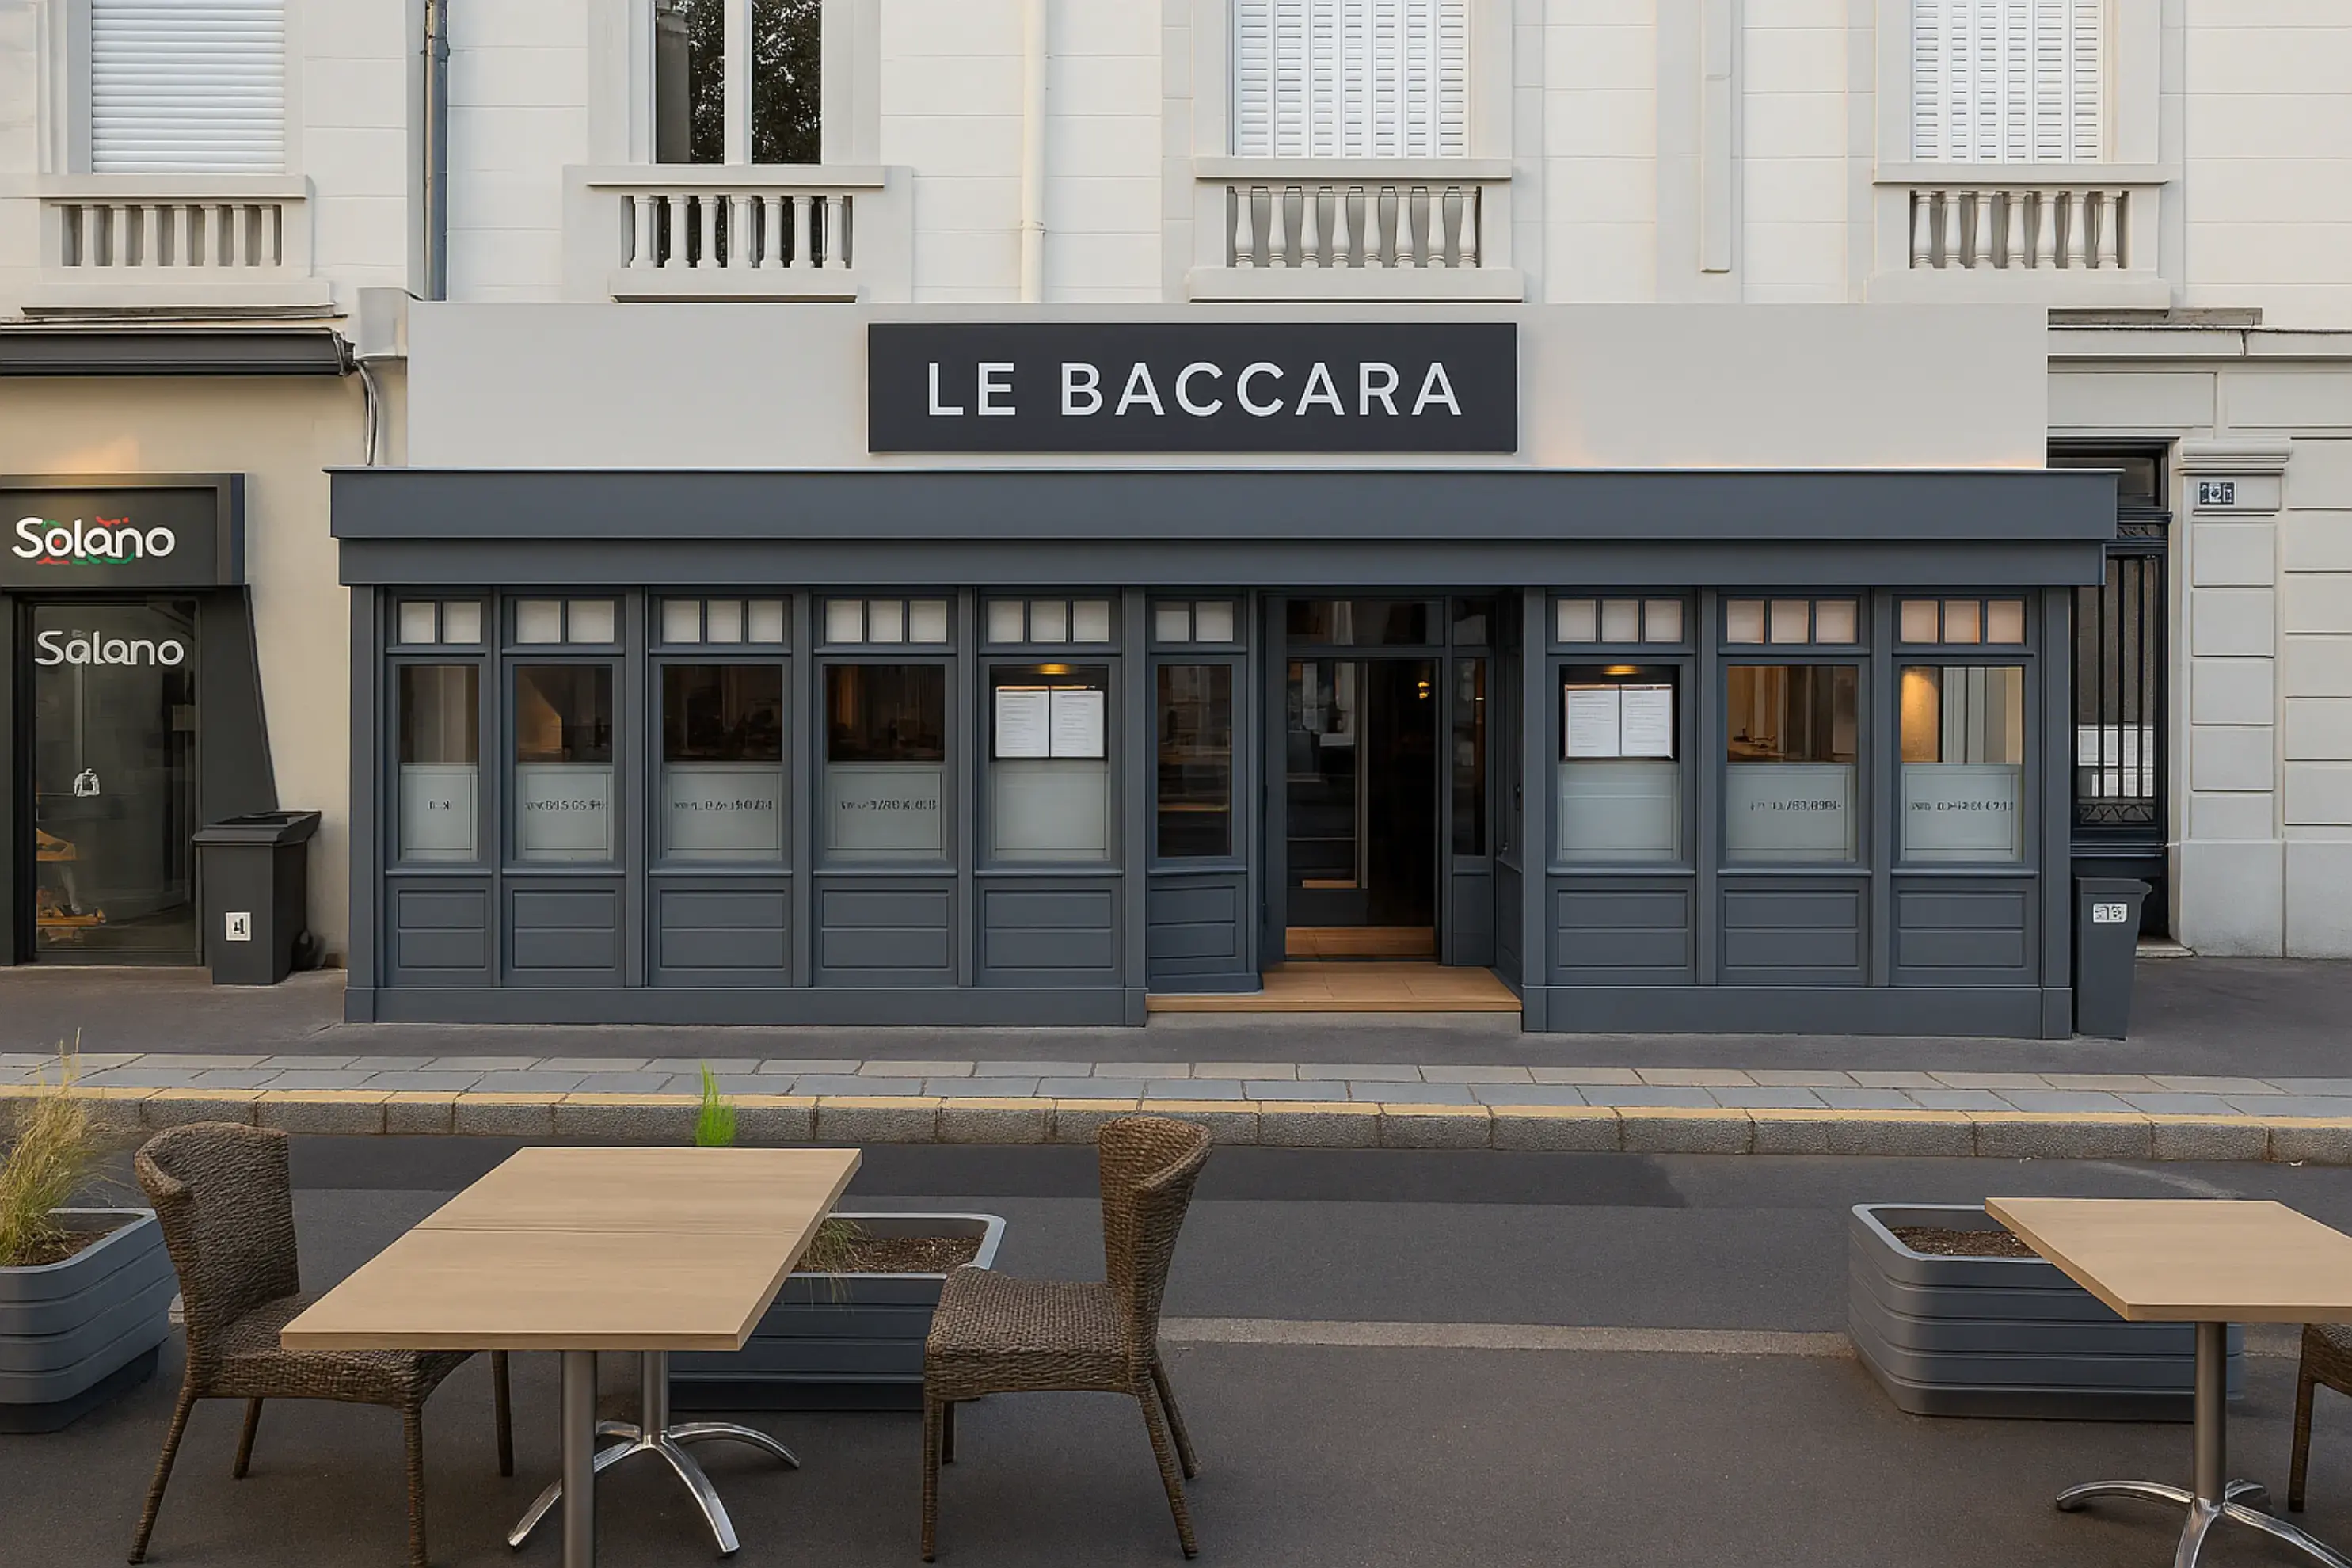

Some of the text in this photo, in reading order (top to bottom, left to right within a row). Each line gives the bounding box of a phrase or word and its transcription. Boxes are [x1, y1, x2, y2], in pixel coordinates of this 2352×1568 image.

[928, 362, 1463, 417] LE BACCARA
[12, 517, 176, 558] Solano
